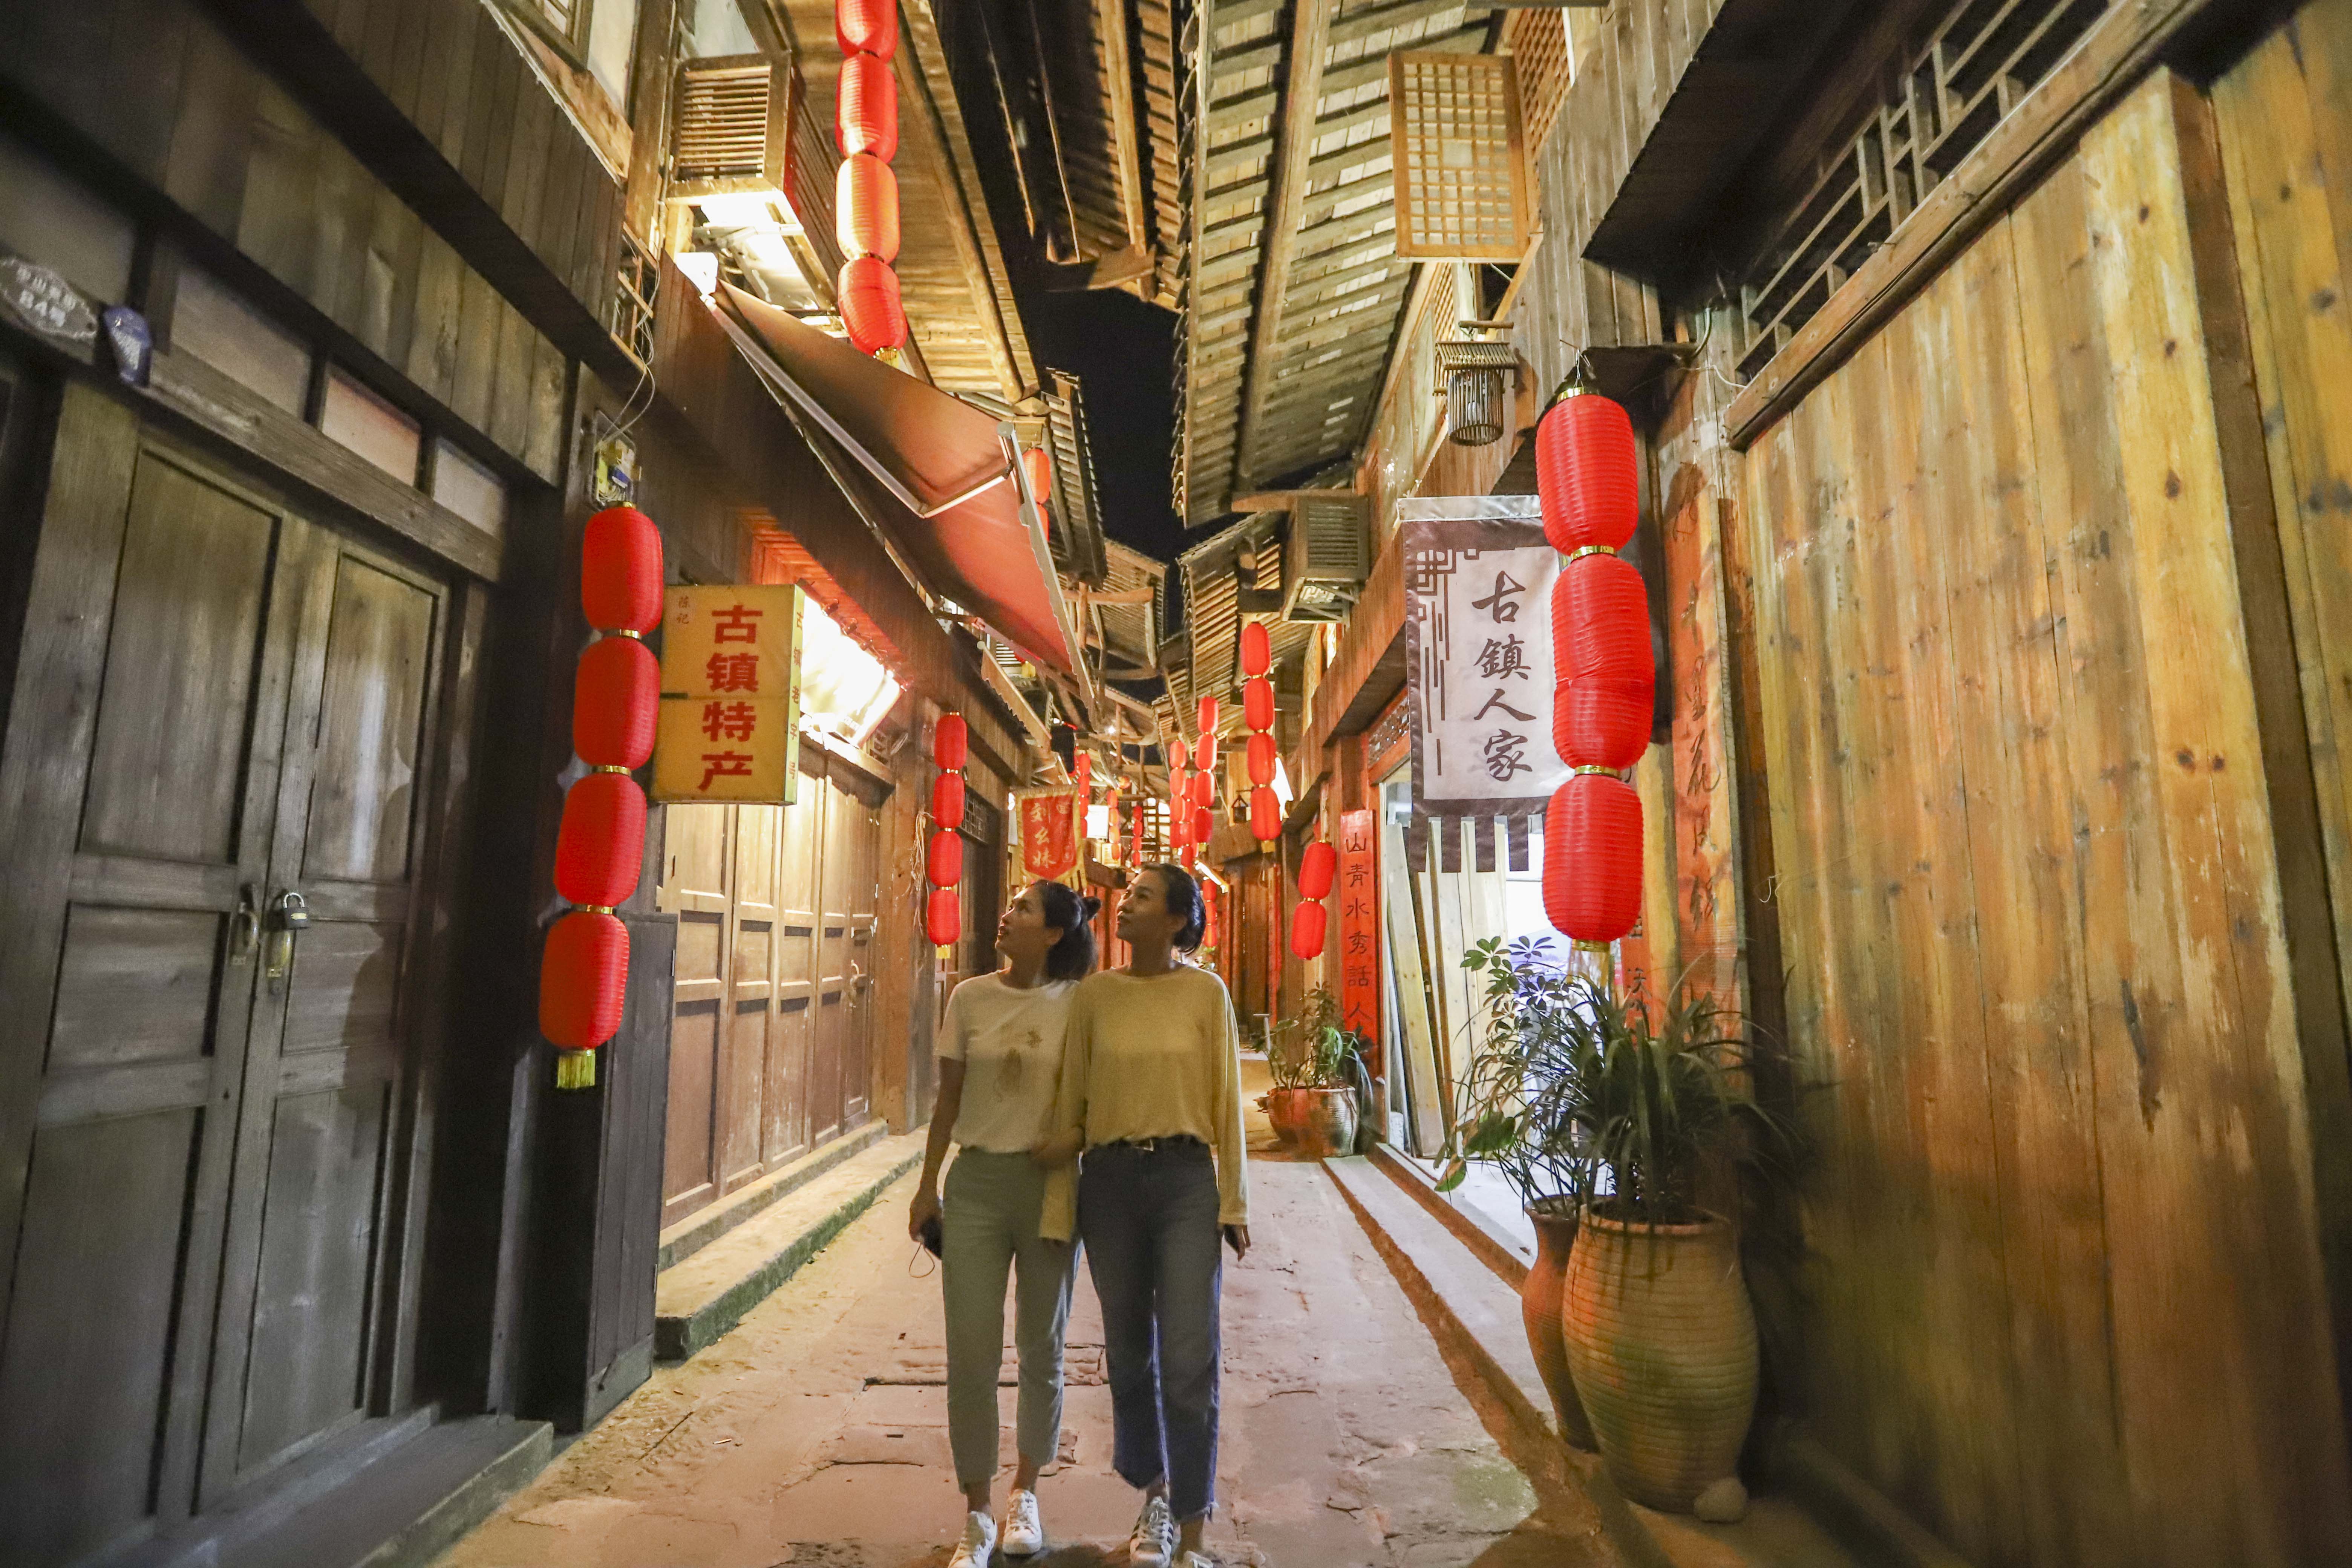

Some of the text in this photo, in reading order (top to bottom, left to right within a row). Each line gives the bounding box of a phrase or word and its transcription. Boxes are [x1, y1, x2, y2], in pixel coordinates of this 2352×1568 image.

[697, 604, 763, 792] 古镇特产
[1472, 570, 1536, 782] 古鎮人家
[1029, 801, 1057, 869] 刘幺妹
